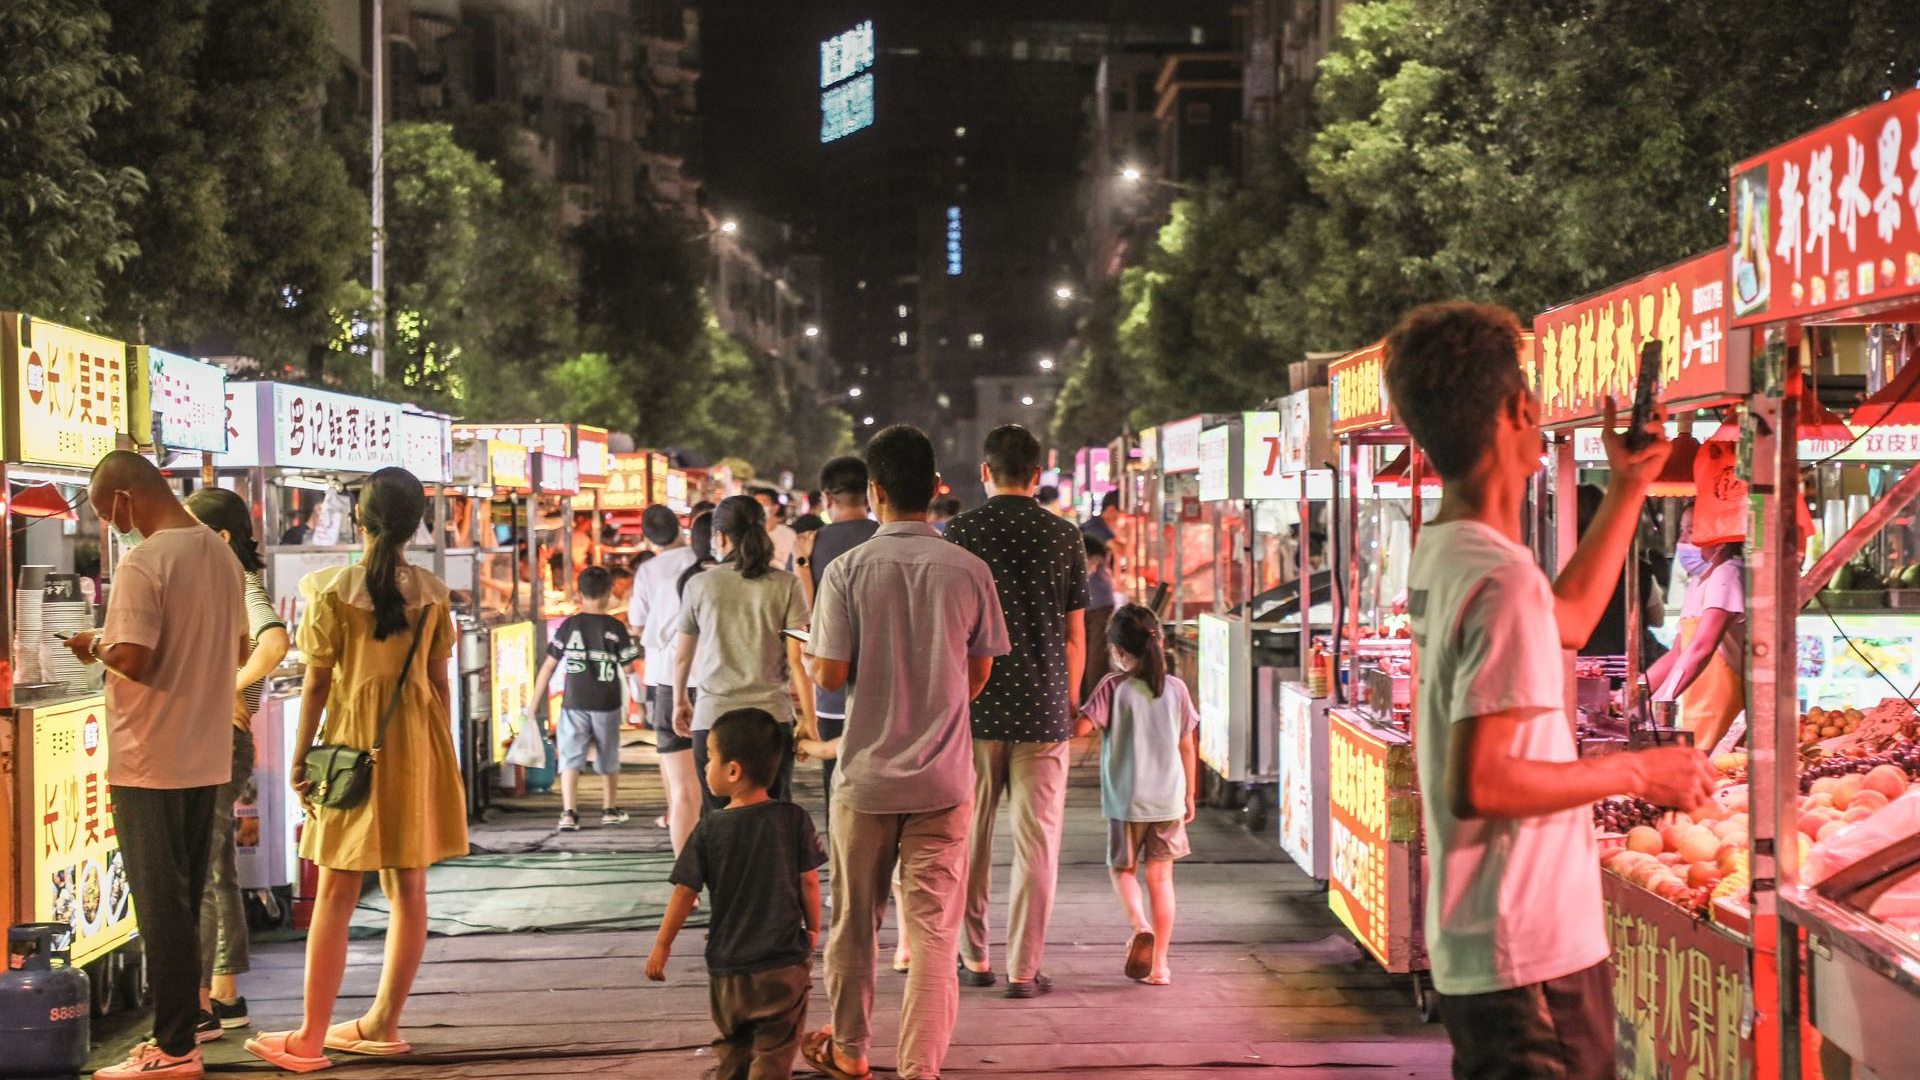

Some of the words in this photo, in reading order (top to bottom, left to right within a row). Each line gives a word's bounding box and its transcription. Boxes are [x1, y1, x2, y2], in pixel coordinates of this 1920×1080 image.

[1776, 112, 1920, 280] 新鲜水果
[47, 341, 121, 428] 长沙臭豆腐
